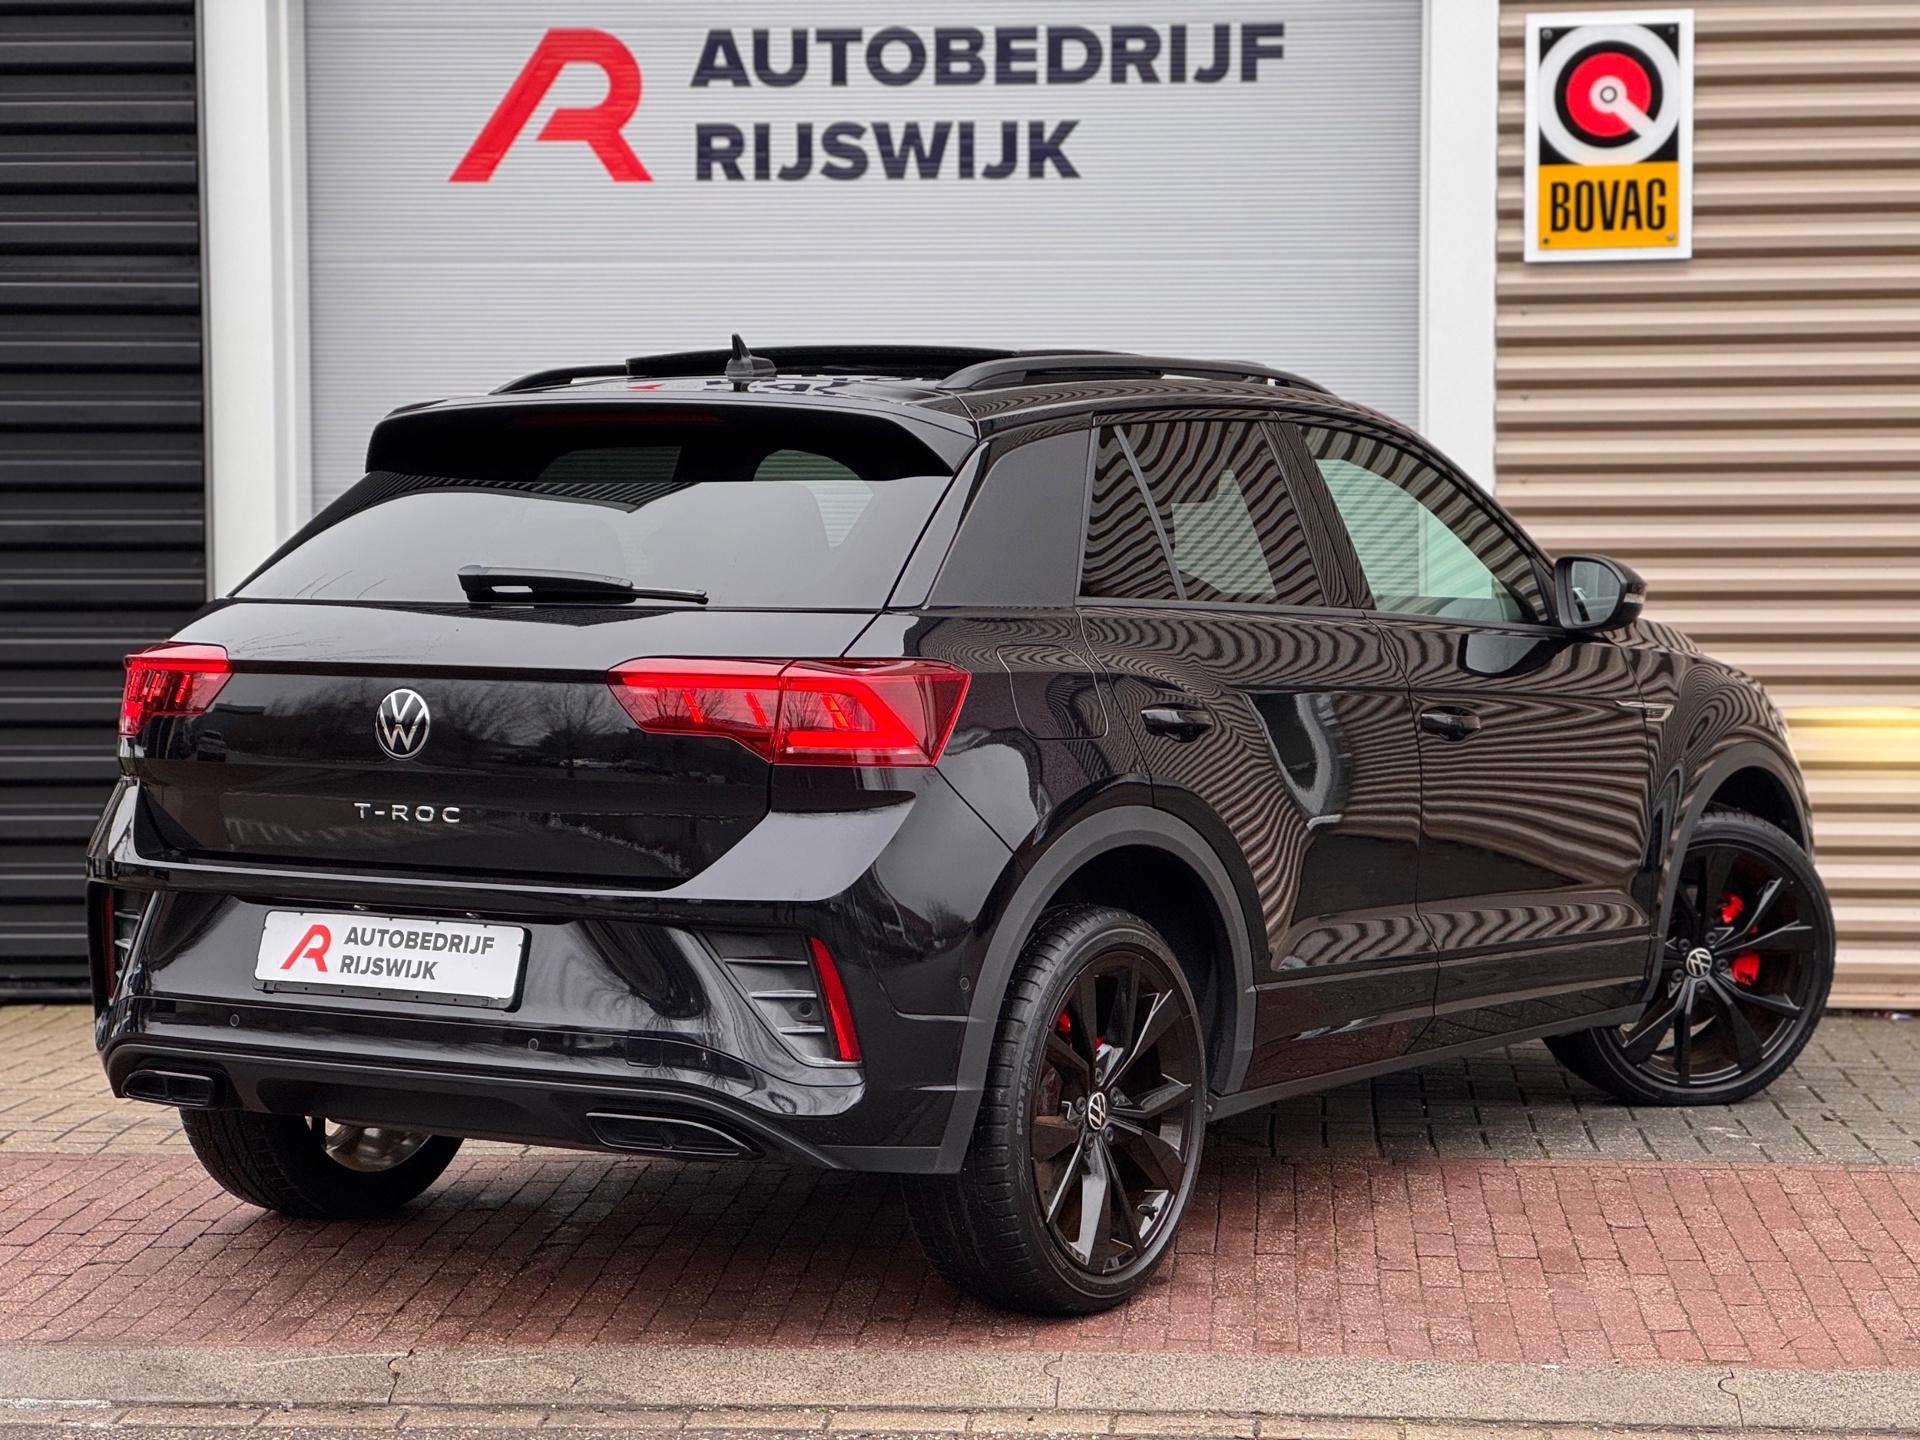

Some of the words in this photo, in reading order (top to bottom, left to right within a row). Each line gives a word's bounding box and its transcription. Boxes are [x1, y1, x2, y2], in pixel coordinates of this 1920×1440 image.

[690, 22, 1285, 88] AUTOBEDRIJF
[696, 120, 1081, 181] RIJSWIJK
[1550, 178, 1666, 233] BOVAG
[354, 802, 460, 823] T-ROC
[344, 927, 495, 955] AUTOBEDRIJF
[339, 955, 438, 980] RIJSWIJK
